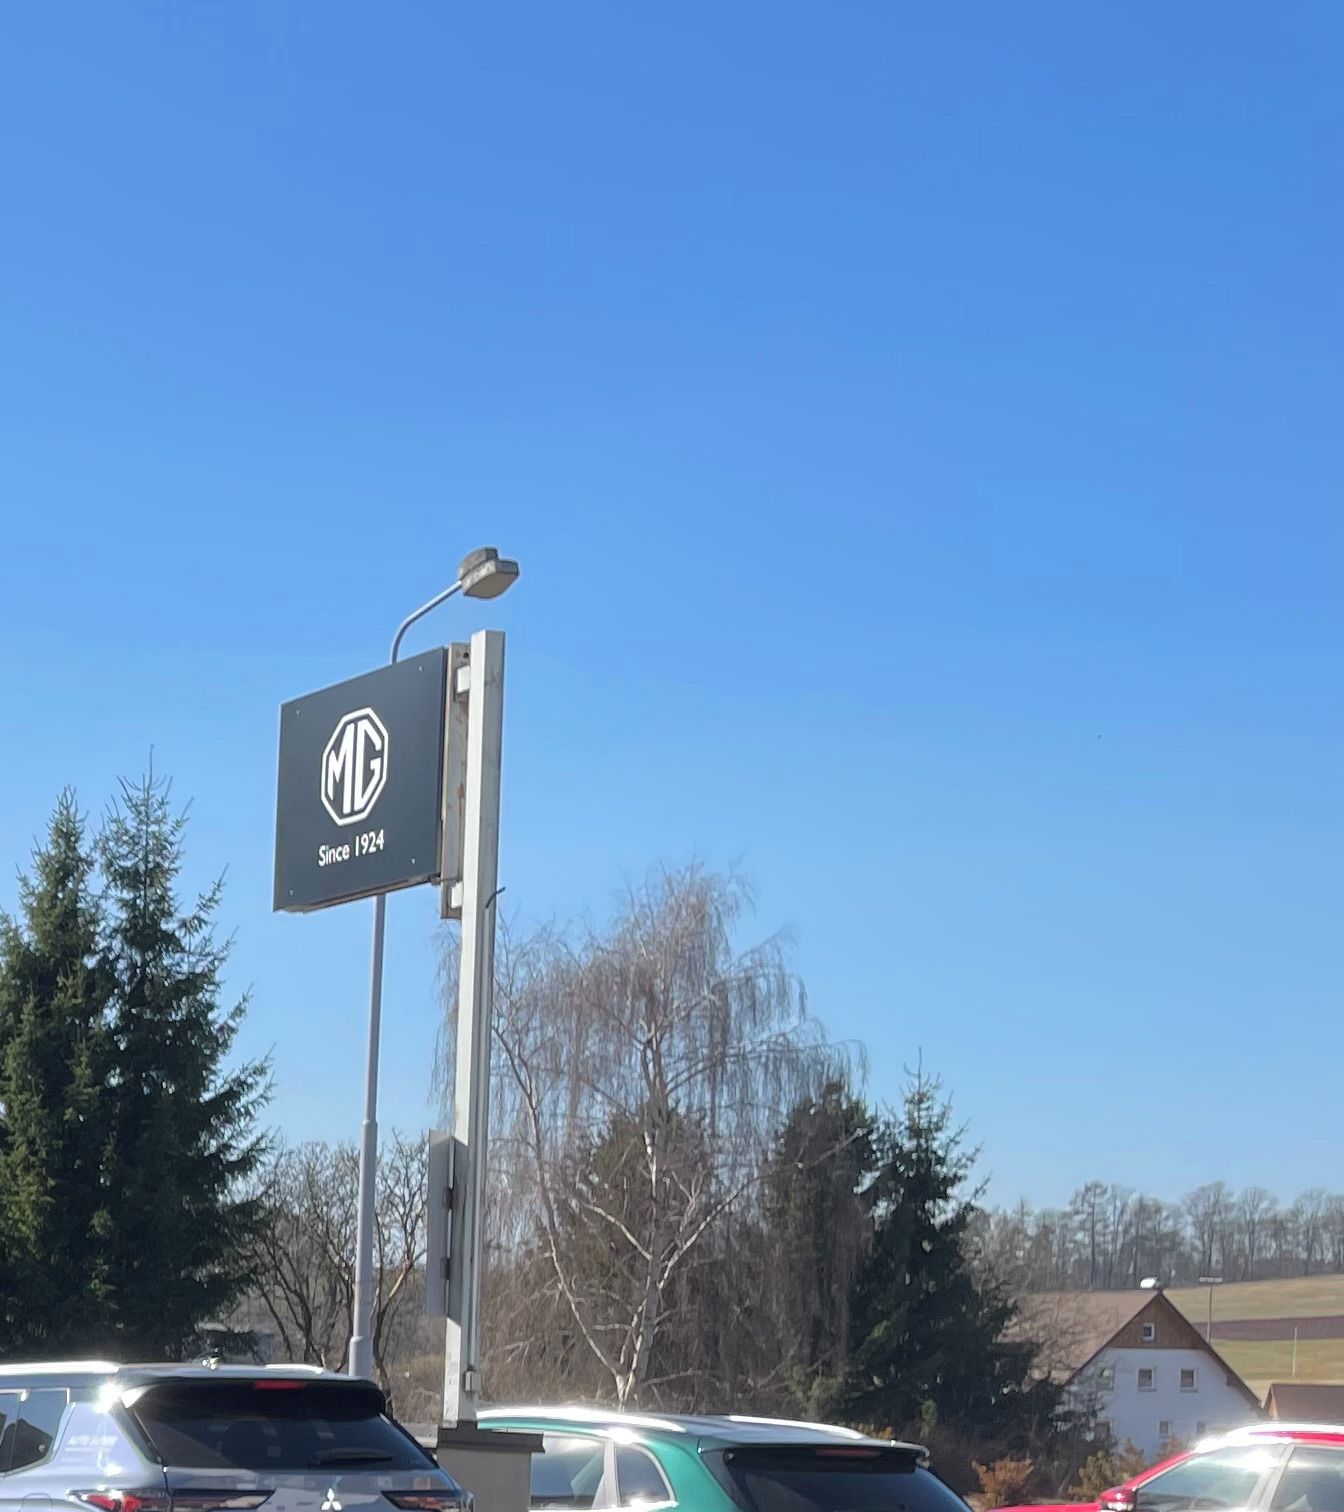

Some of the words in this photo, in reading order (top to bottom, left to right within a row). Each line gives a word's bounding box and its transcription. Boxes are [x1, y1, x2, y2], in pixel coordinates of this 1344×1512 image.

[326, 719, 382, 814] MG
[318, 844, 350, 867] Since
[355, 829, 385, 857] 1924
